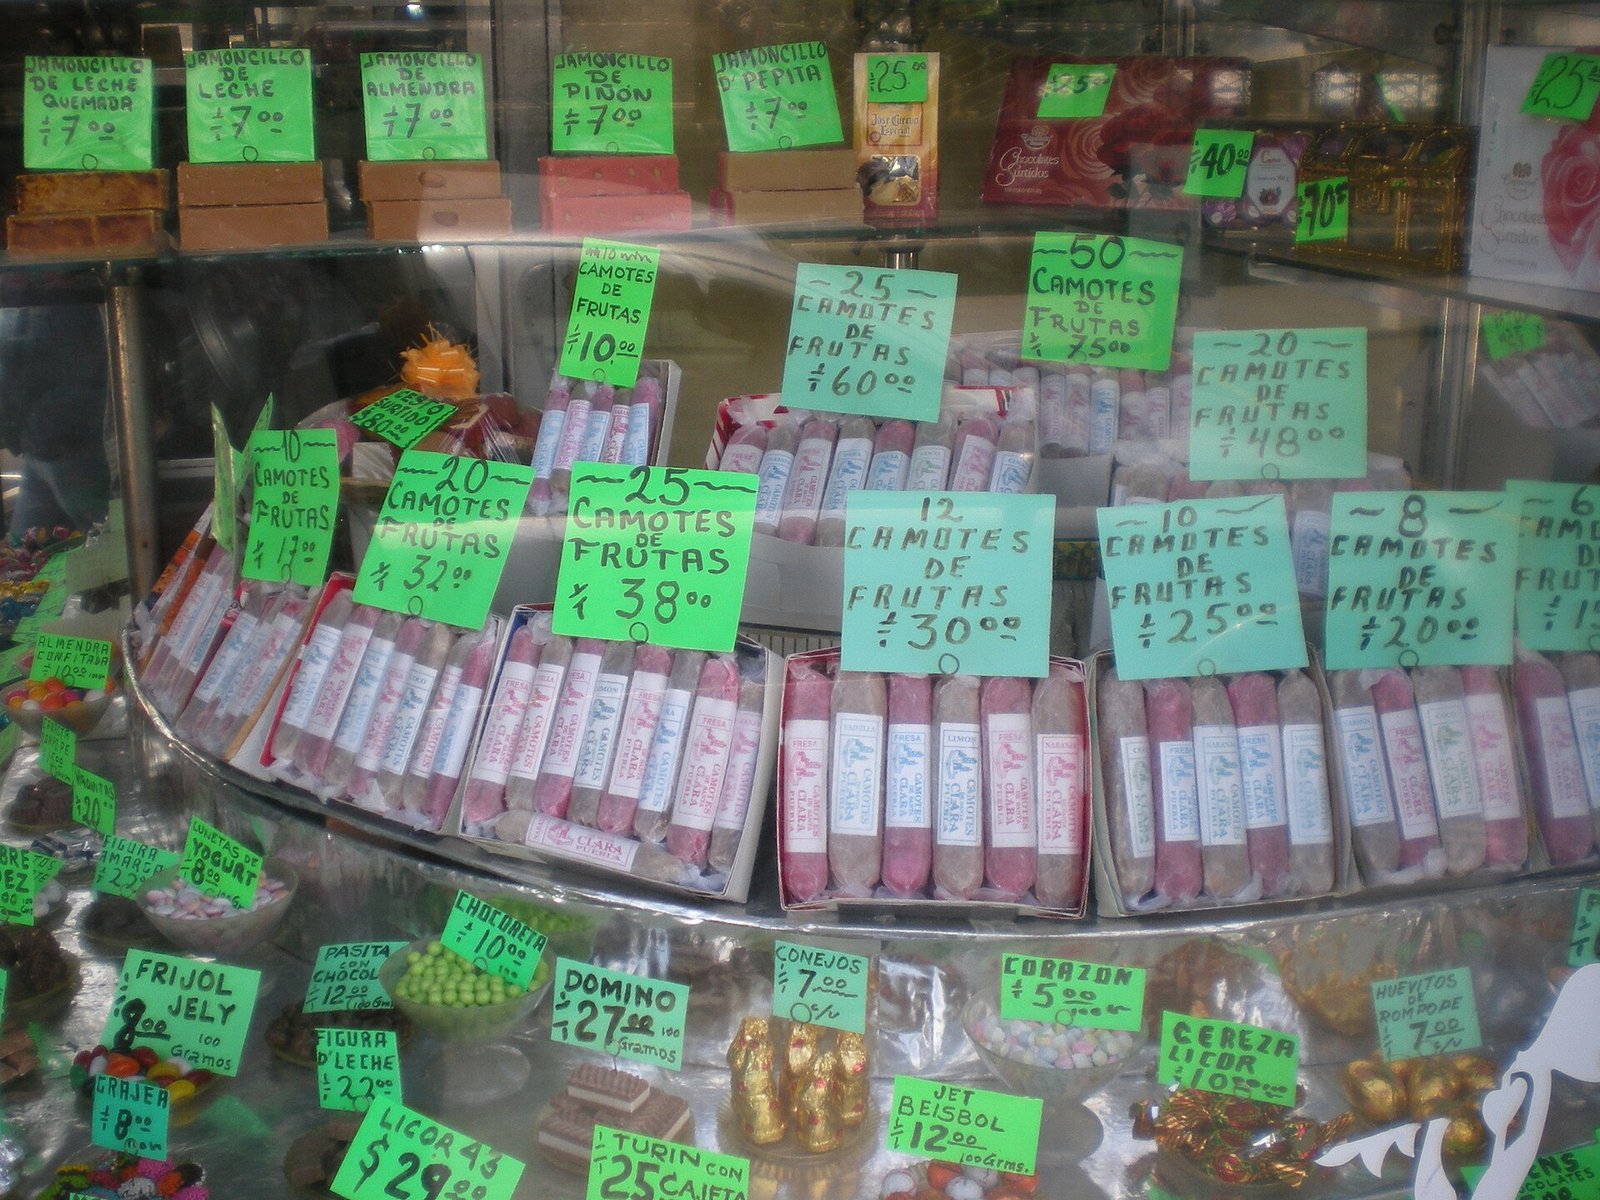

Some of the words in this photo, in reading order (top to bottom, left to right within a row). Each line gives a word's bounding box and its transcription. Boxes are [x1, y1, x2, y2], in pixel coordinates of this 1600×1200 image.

[25, 58, 144, 73] JAMONCILLO
[188, 51, 304, 68] JAMONCILLO
[363, 54, 476, 68] JAMONCILLO
[555, 54, 670, 72] JAMONCILLO
[716, 41, 827, 72] JAMONCILLO
[29, 76, 58, 91] DE
[72, 76, 137, 92] LECHE
[218, 67, 248, 82] DE
[396, 68, 423, 81] DE
[584, 70, 621, 84] DE
[743, 64, 822, 91] PEPITA
[43, 93, 133, 111] QUEMADA
[199, 80, 274, 98] LECHE
[366, 81, 476, 97] ALMENDRA
[1070, 234, 1126, 270] 50
[579, 261, 655, 284] CAMOTES
[840, 271, 895, 300] 25
[1032, 266, 1156, 306] CAMOTES
[601, 283, 622, 297] DE
[576, 297, 642, 324] FRUTAS
[796, 294, 935, 331] CAMOTES
[1075, 300, 1104, 315] DE
[845, 323, 876, 340] DE
[1029, 306, 1140, 337] FRUTAS
[788, 335, 911, 367] FRUTAS
[1248, 331, 1299, 358] 20
[1196, 358, 1351, 387] CAMOTES
[395, 390, 444, 415] CESTO
[1256, 383, 1289, 402] DE
[374, 398, 431, 426] SURTIDO
[1194, 402, 1331, 428] FRUTAS
[280, 430, 301, 463] 10
[254, 464, 330, 488] CAMOTES
[435, 456, 489, 494] 20
[625, 466, 690, 506] 25
[282, 491, 298, 504] DE
[387, 480, 510, 522] CAMOTES
[921, 497, 964, 523] 12
[1571, 485, 1594, 516] 6
[256, 500, 330, 530] FRUTAS
[433, 516, 457, 530] DE
[573, 497, 736, 538] CAMOTES
[1162, 505, 1198, 534] 10
[1398, 494, 1429, 538] 8
[379, 515, 501, 558] FRUTAS
[635, 532, 664, 548] DE
[846, 526, 1030, 554] CAMOTES
[1106, 525, 1269, 557] CAMOTES
[1330, 534, 1497, 563] CAMOTES
[568, 537, 730, 575] FRUTAS
[924, 555, 971, 579] DE
[1177, 552, 1214, 579] DE
[1111, 571, 1252, 609] FRUTAS
[1399, 565, 1437, 589] DE
[847, 583, 1008, 610] FRUTAS
[1331, 585, 1467, 612] FRUTAS
[37, 651, 108, 666] CONFITADA
[38, 635, 109, 655] ALMENDRA
[103, 835, 158, 860] FIGURA
[193, 822, 239, 859] LUNETAS
[244, 854, 259, 867] DE
[577, 835, 623, 855] CLARA
[193, 838, 258, 886] YOGURT
[455, 892, 547, 952] CHOCORETA
[325, 944, 391, 961] PASITA
[340, 960, 369, 969] CON
[775, 946, 862, 974] CONEJOS
[136, 959, 232, 995] FRIJOL
[313, 968, 379, 982] CHOCOL
[1003, 956, 1133, 986] CORAZON
[564, 968, 676, 1013] DOMINO
[1376, 972, 1458, 1000] HUEVITOS
[1407, 991, 1423, 1006] DE
[168, 995, 235, 1026] JELY
[1379, 997, 1463, 1024] ROMPOPE
[317, 1031, 387, 1048] FIGURA
[1173, 1021, 1295, 1058] CEREZA
[1168, 1045, 1257, 1075] LICOR
[95, 1077, 169, 1109] GRAJEA
[934, 1085, 976, 1107] JET
[898, 1096, 1006, 1133] BEISBOL
[379, 1107, 454, 1159] LICOR
[613, 1133, 700, 1167] TURIN
[706, 1163, 743, 1182] CON
